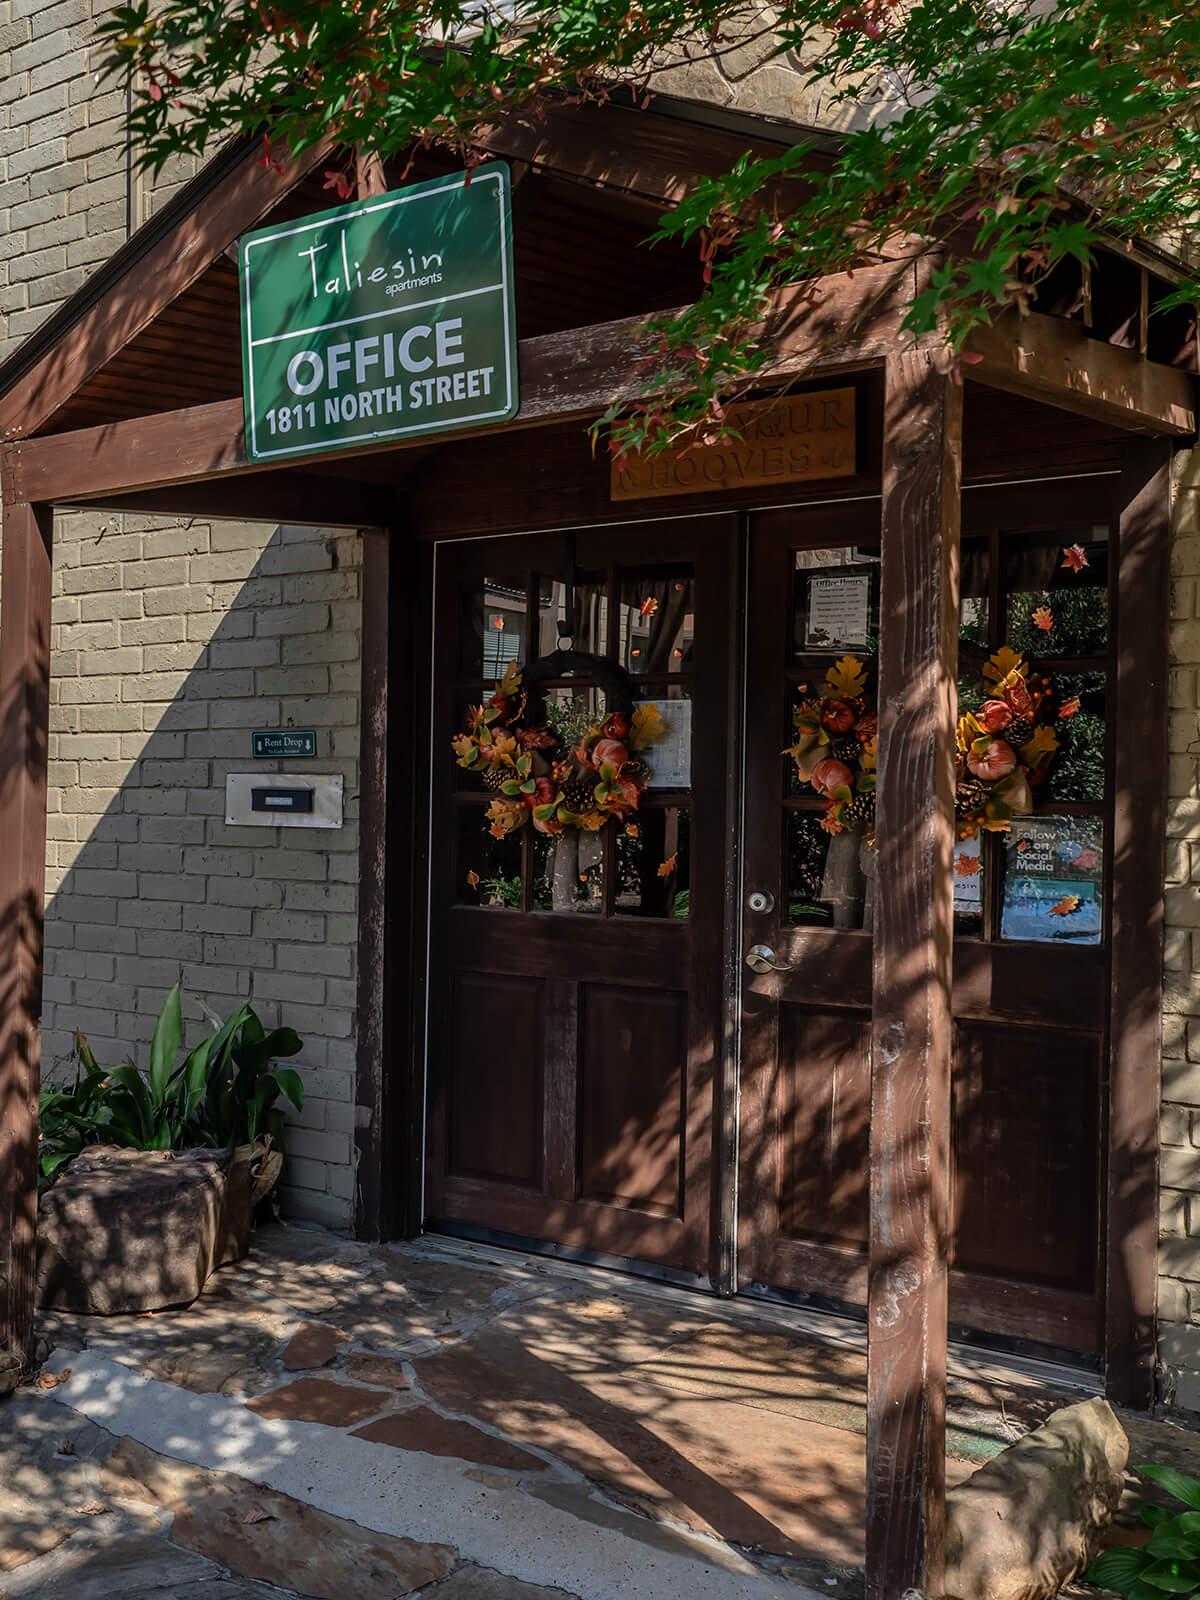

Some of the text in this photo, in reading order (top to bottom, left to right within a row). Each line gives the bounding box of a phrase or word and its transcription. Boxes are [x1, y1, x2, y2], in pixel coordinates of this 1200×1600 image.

[298, 229, 443, 297] Taliesin
[385, 271, 443, 297] apartments
[286, 317, 466, 397] OFFICE
[265, 366, 495, 435] 1811 NORTH STREET
[264, 736, 303, 748] Rent Drop
[1016, 828, 1056, 840] Follow
[1033, 842, 1049, 850] on
[1016, 849, 1052, 861] Social
[1016, 859, 1054, 871] Media
